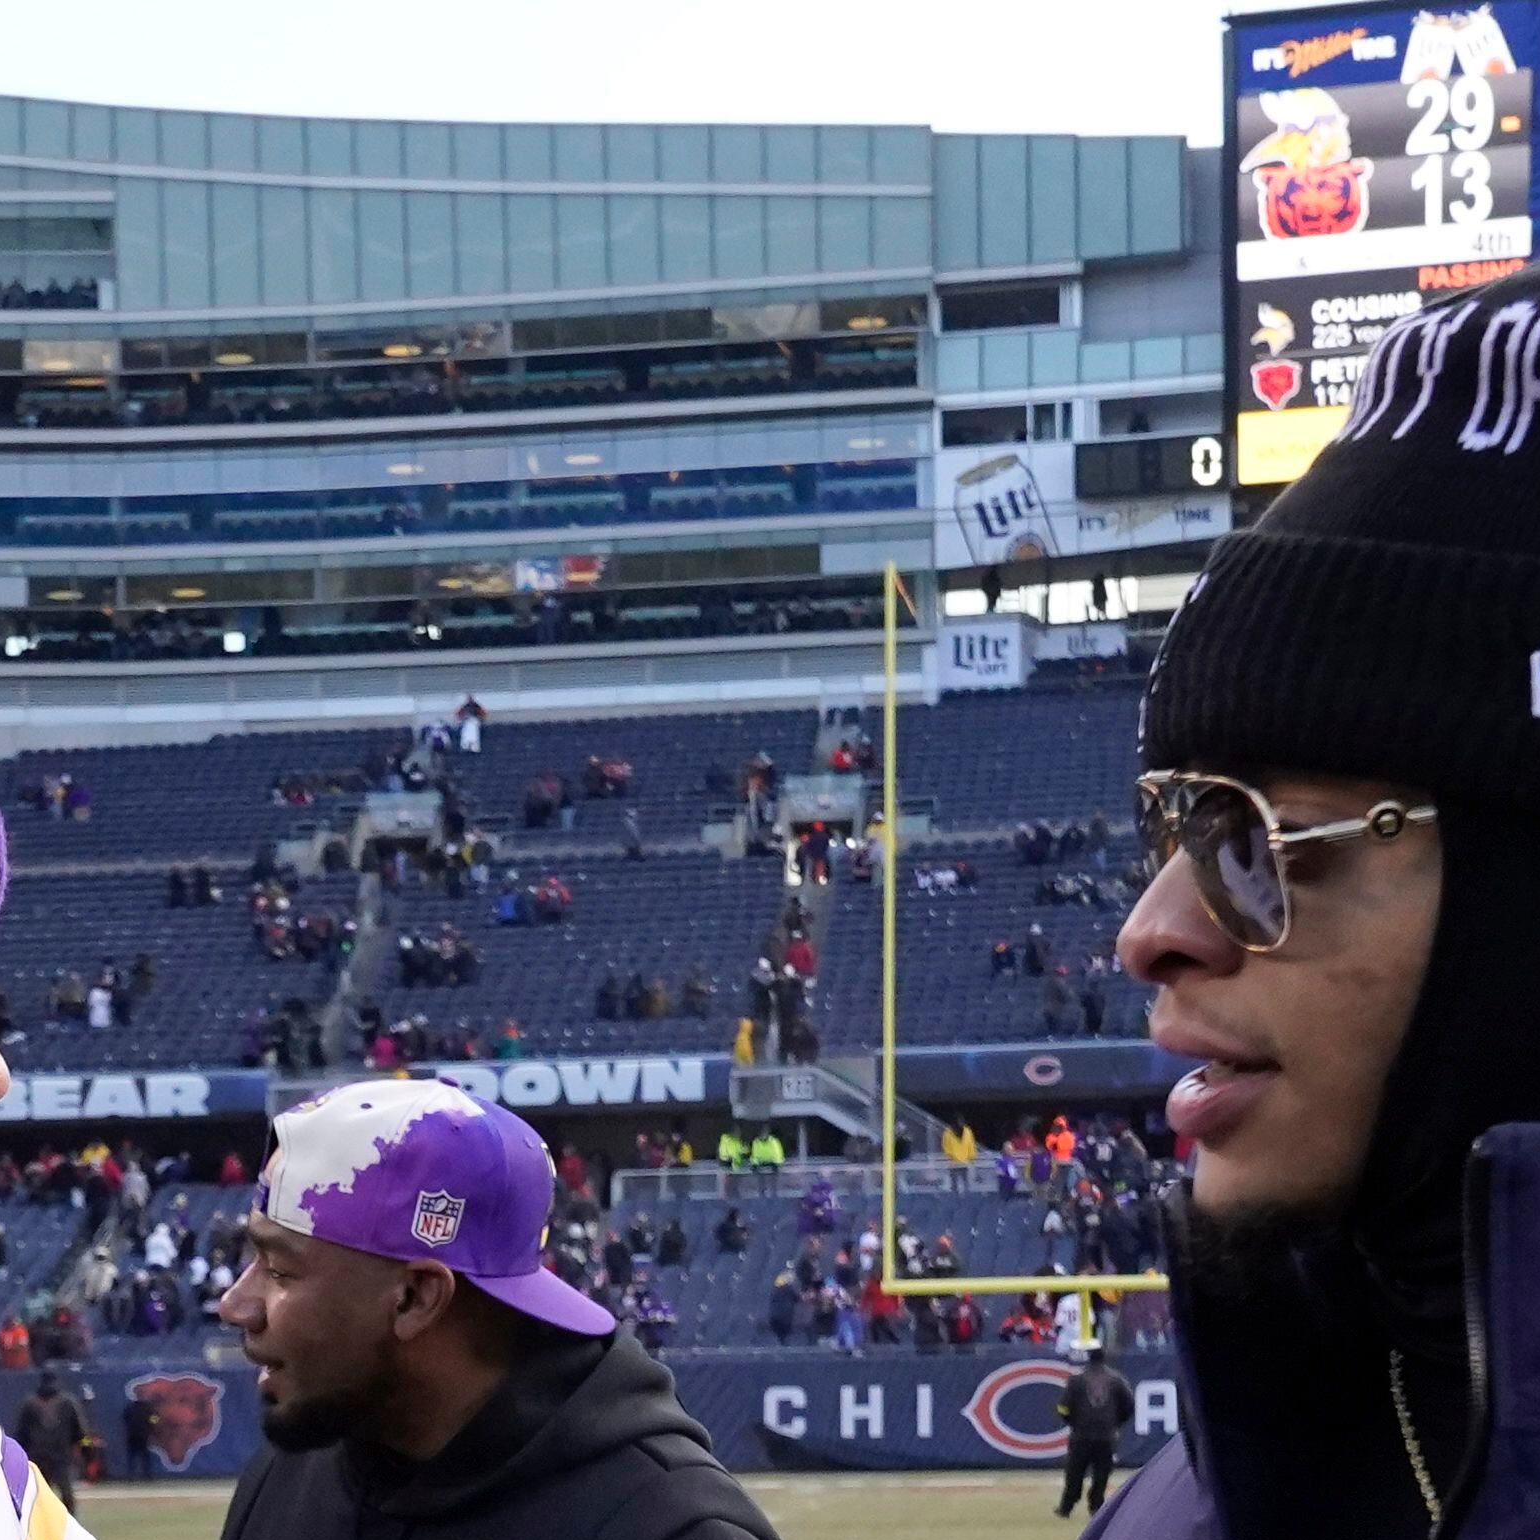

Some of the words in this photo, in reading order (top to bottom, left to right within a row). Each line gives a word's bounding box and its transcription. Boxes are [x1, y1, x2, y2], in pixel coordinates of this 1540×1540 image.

[1405, 77, 1495, 156] 29
[1411, 150, 1493, 228] 13
[1311, 291, 1423, 324] COUSINS
[1191, 436, 1223, 487] 0
[953, 633, 1009, 670] Lite
[438, 1059, 704, 1104] DOWN
[418, 1213, 451, 1238] NFL
